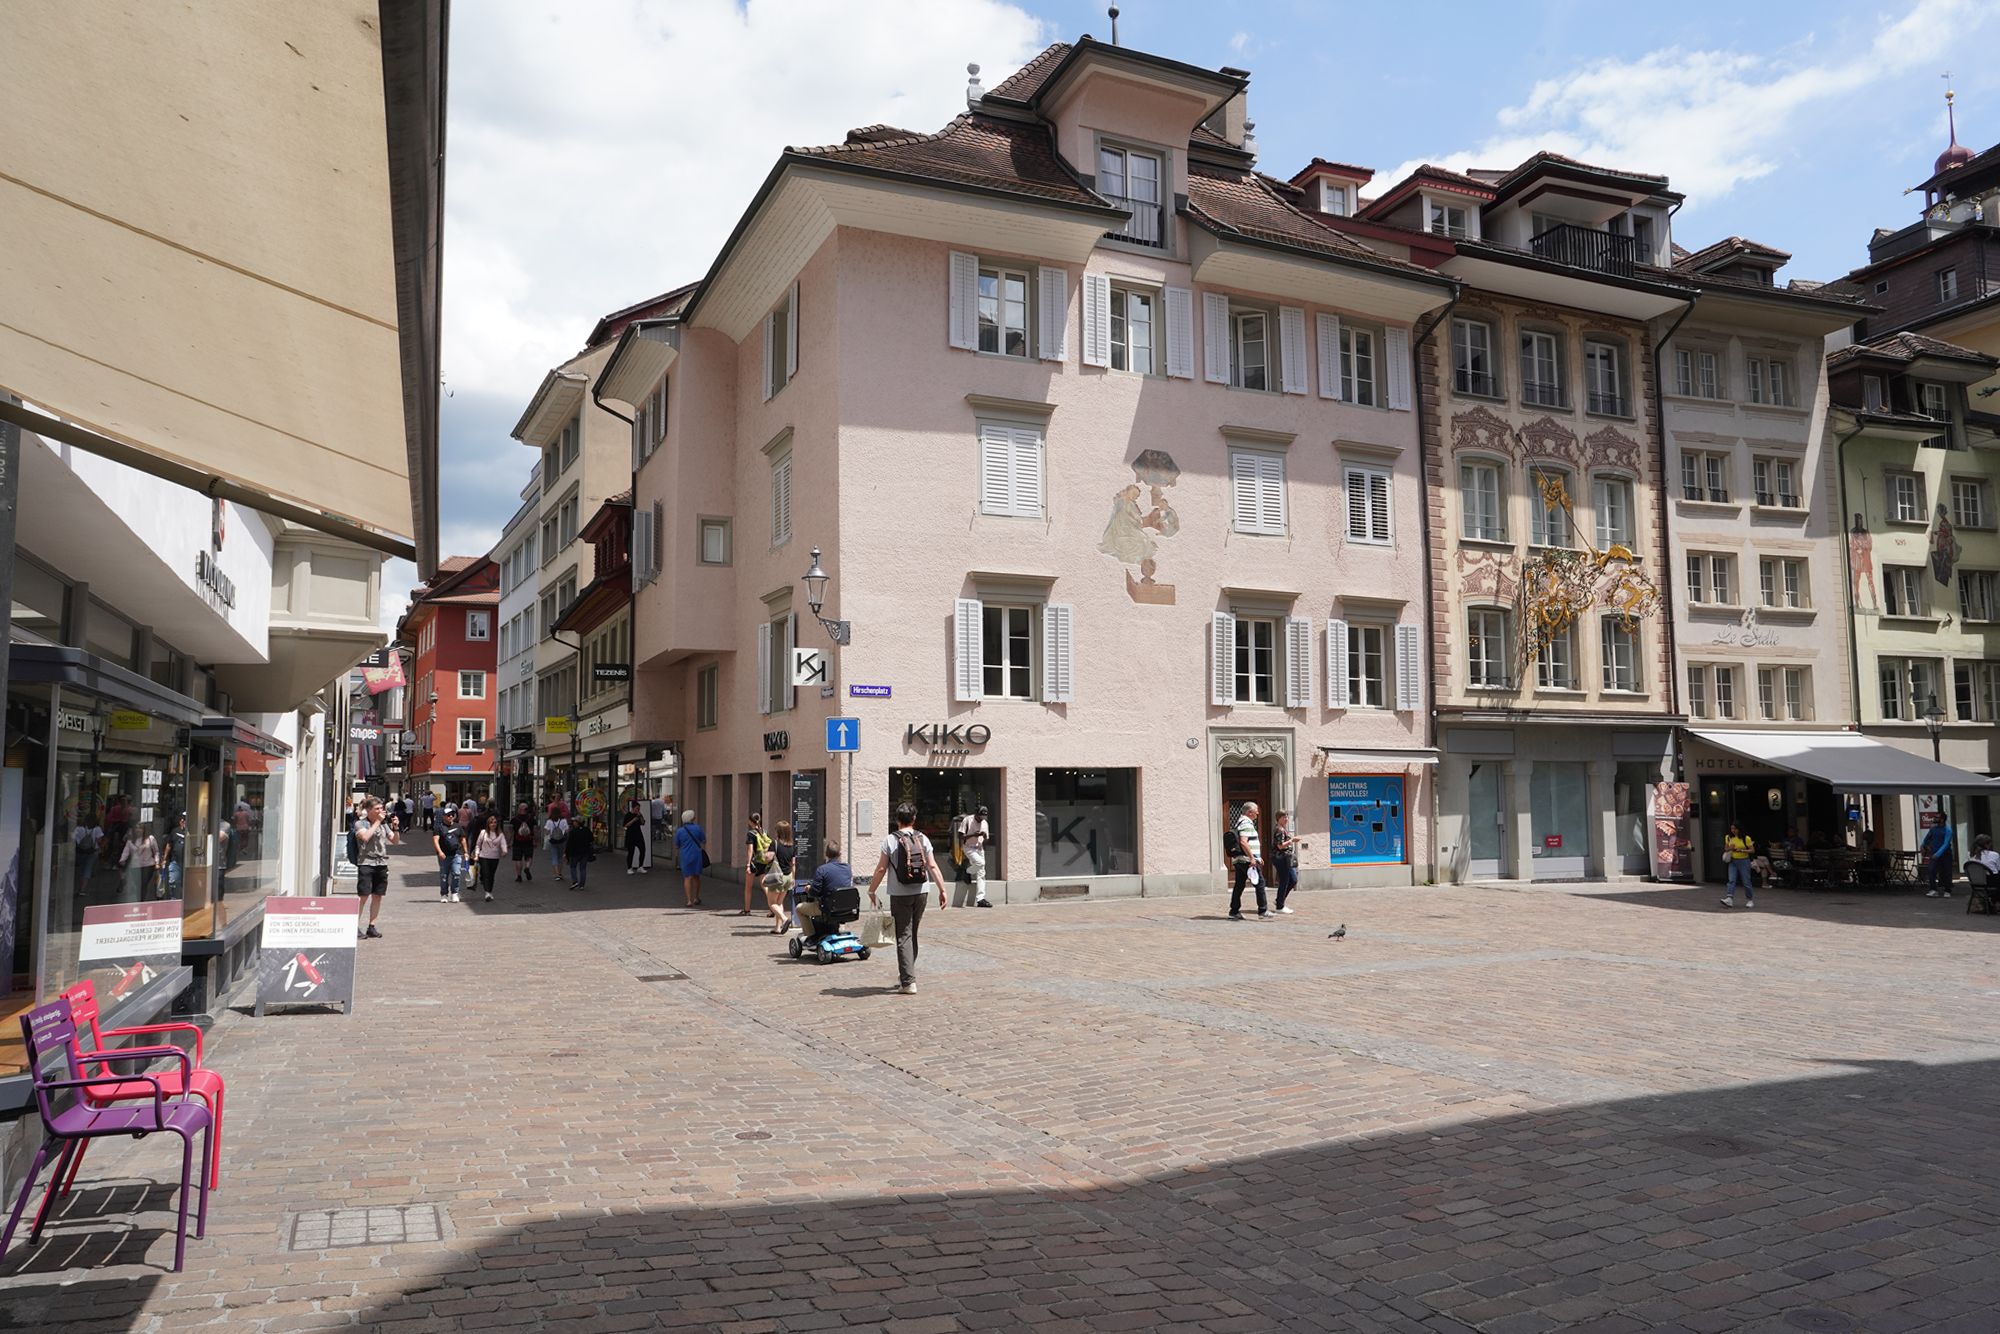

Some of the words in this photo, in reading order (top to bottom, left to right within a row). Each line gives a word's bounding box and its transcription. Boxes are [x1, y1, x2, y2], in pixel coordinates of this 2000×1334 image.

[595, 668, 627, 676] TEZENIS
[853, 686, 889, 695] Hirschenplatz
[350, 727, 378, 740] snipes
[907, 723, 992, 746] KIKO
[1695, 759, 1744, 769] HOTEL
[1329, 782, 1347, 790] MACH
[1347, 782, 1368, 790] ETWAS
[1329, 790, 1369, 798] SINNVOLLES!
[1331, 839, 1357, 847] BEGINNE
[1331, 847, 1346, 855] HIER
